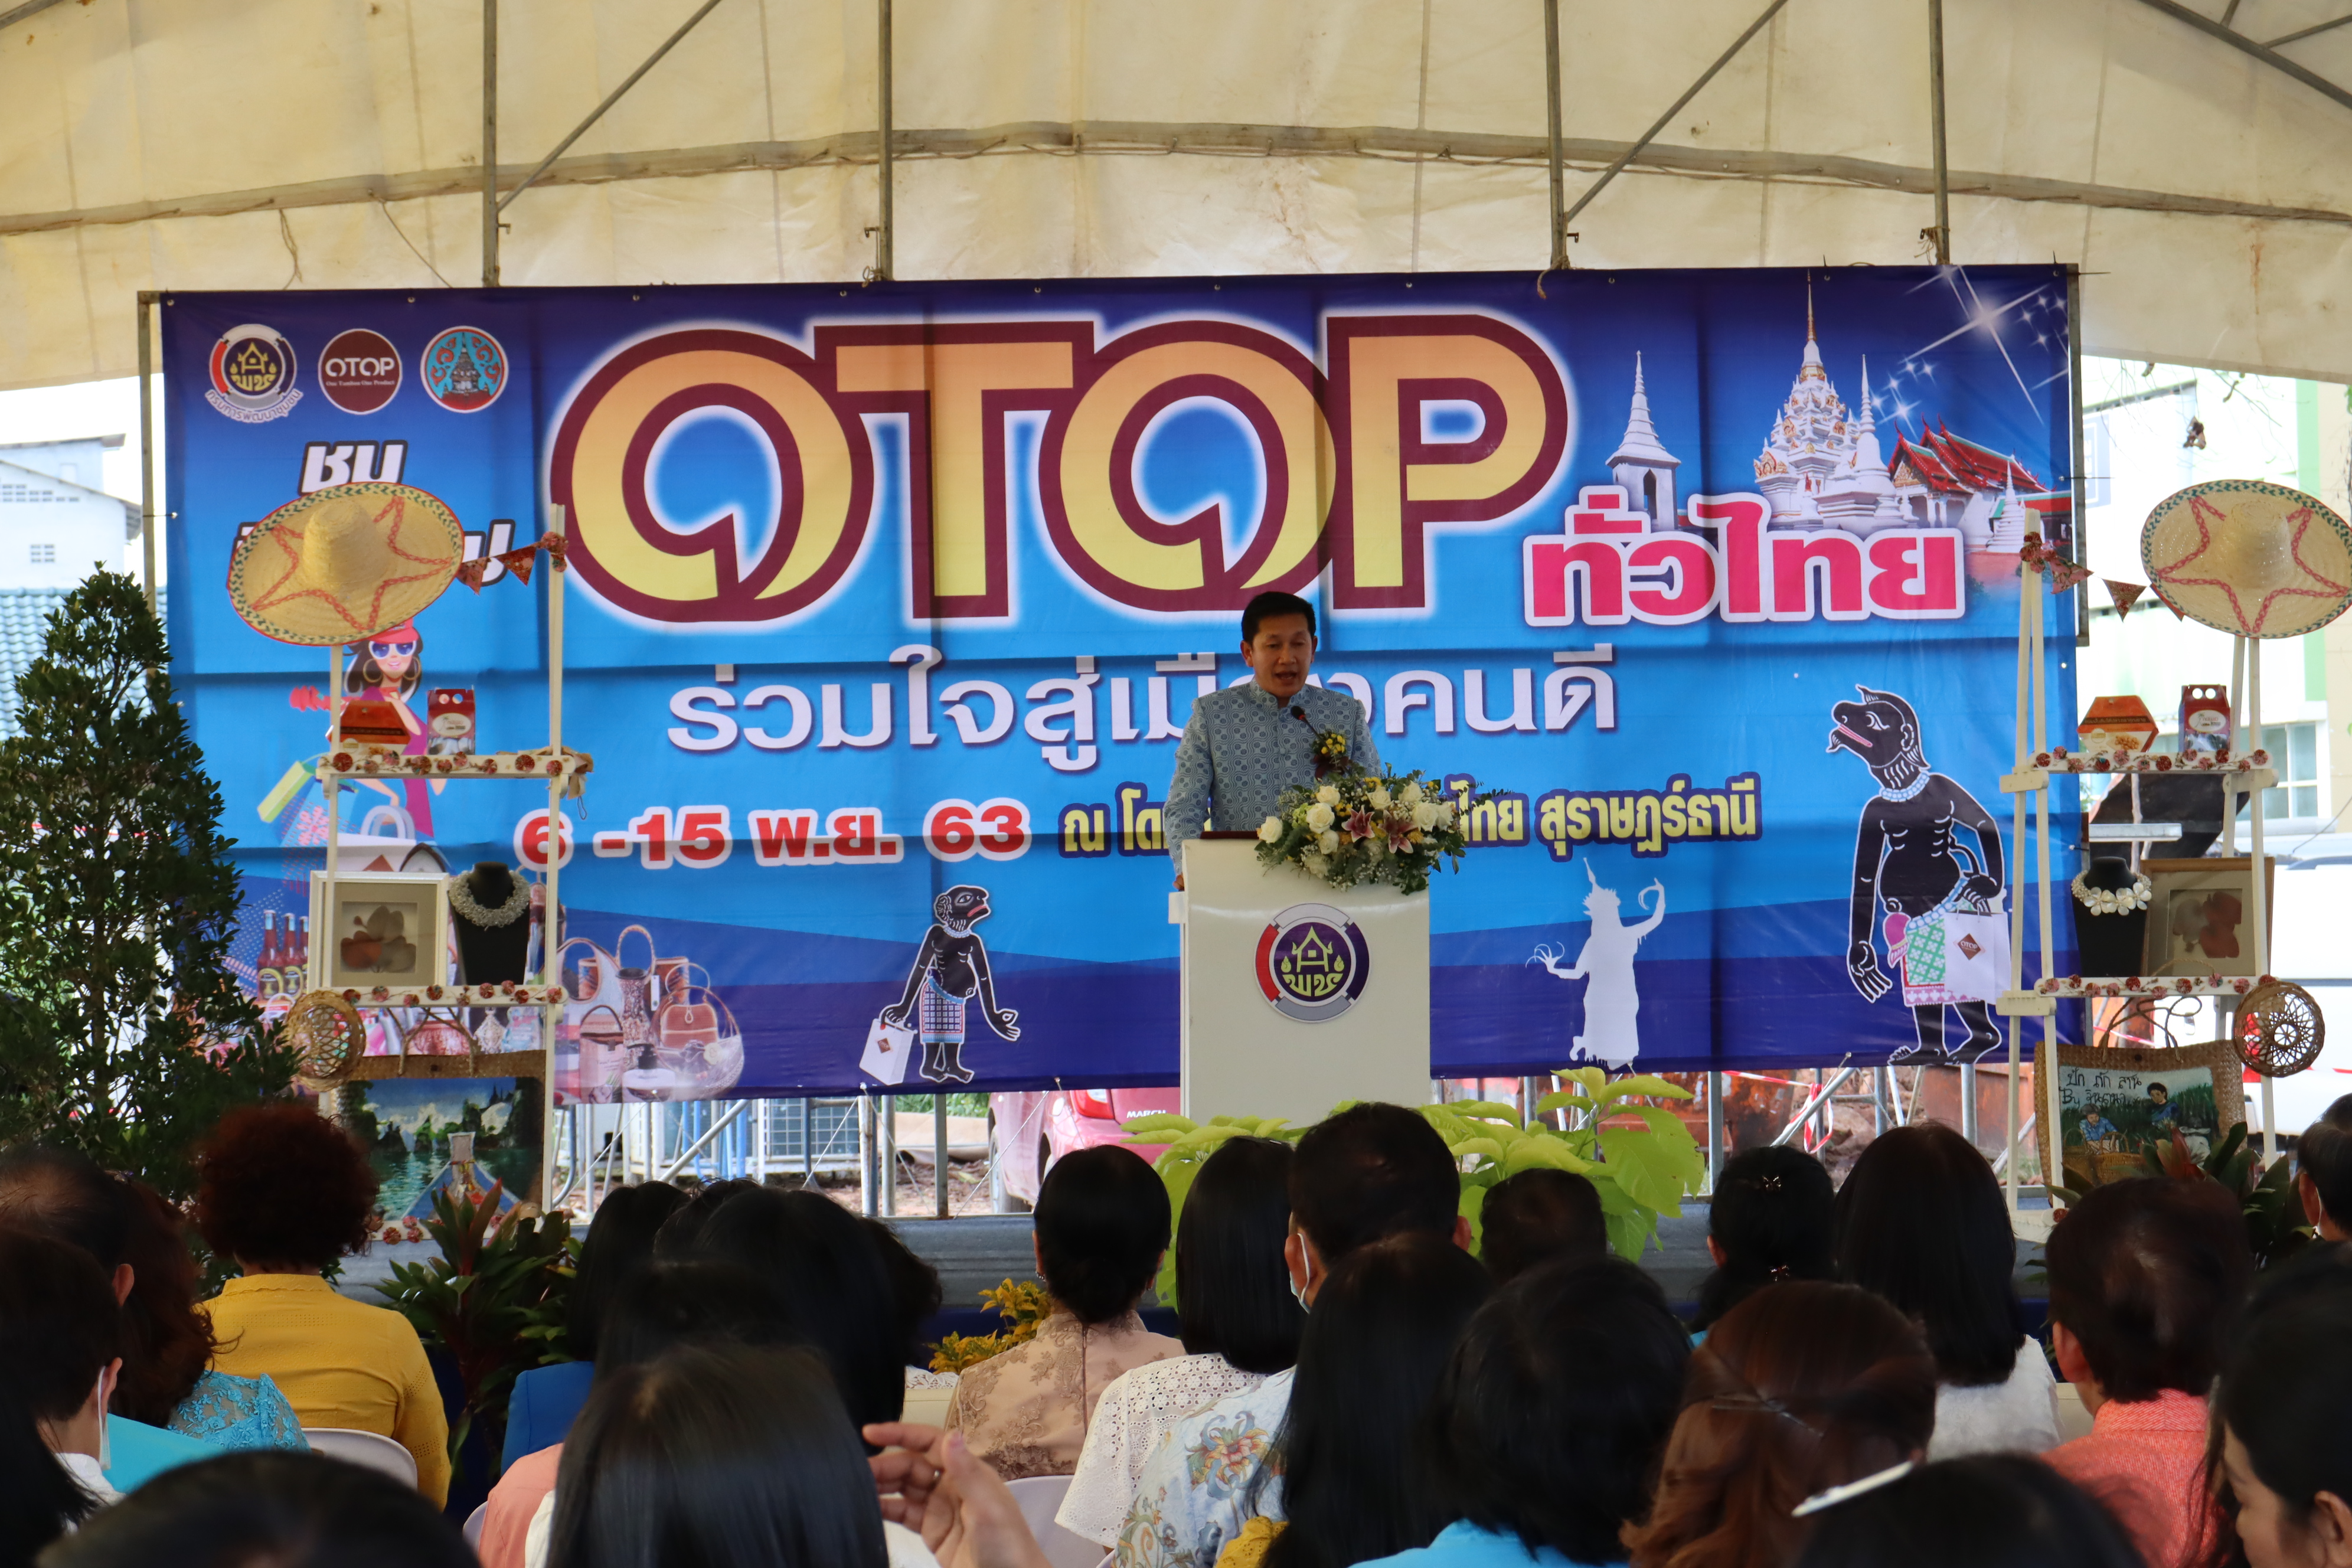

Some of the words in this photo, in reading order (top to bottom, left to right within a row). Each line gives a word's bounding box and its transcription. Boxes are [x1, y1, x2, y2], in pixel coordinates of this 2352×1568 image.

[325, 357, 395, 377] OTOP
[206, 389, 302, 422] กรมการพัฒนาชุมชน
[549, 314, 1568, 624] OTOP
[1528, 489, 1960, 621] ทั่วไทย
[667, 643, 1616, 770] ร่วมใจสู่เมืคนดี
[753, 812, 900, 861] พ.ย.
[927, 801, 1028, 857] 63
[2059, 1086, 2080, 1109] By
